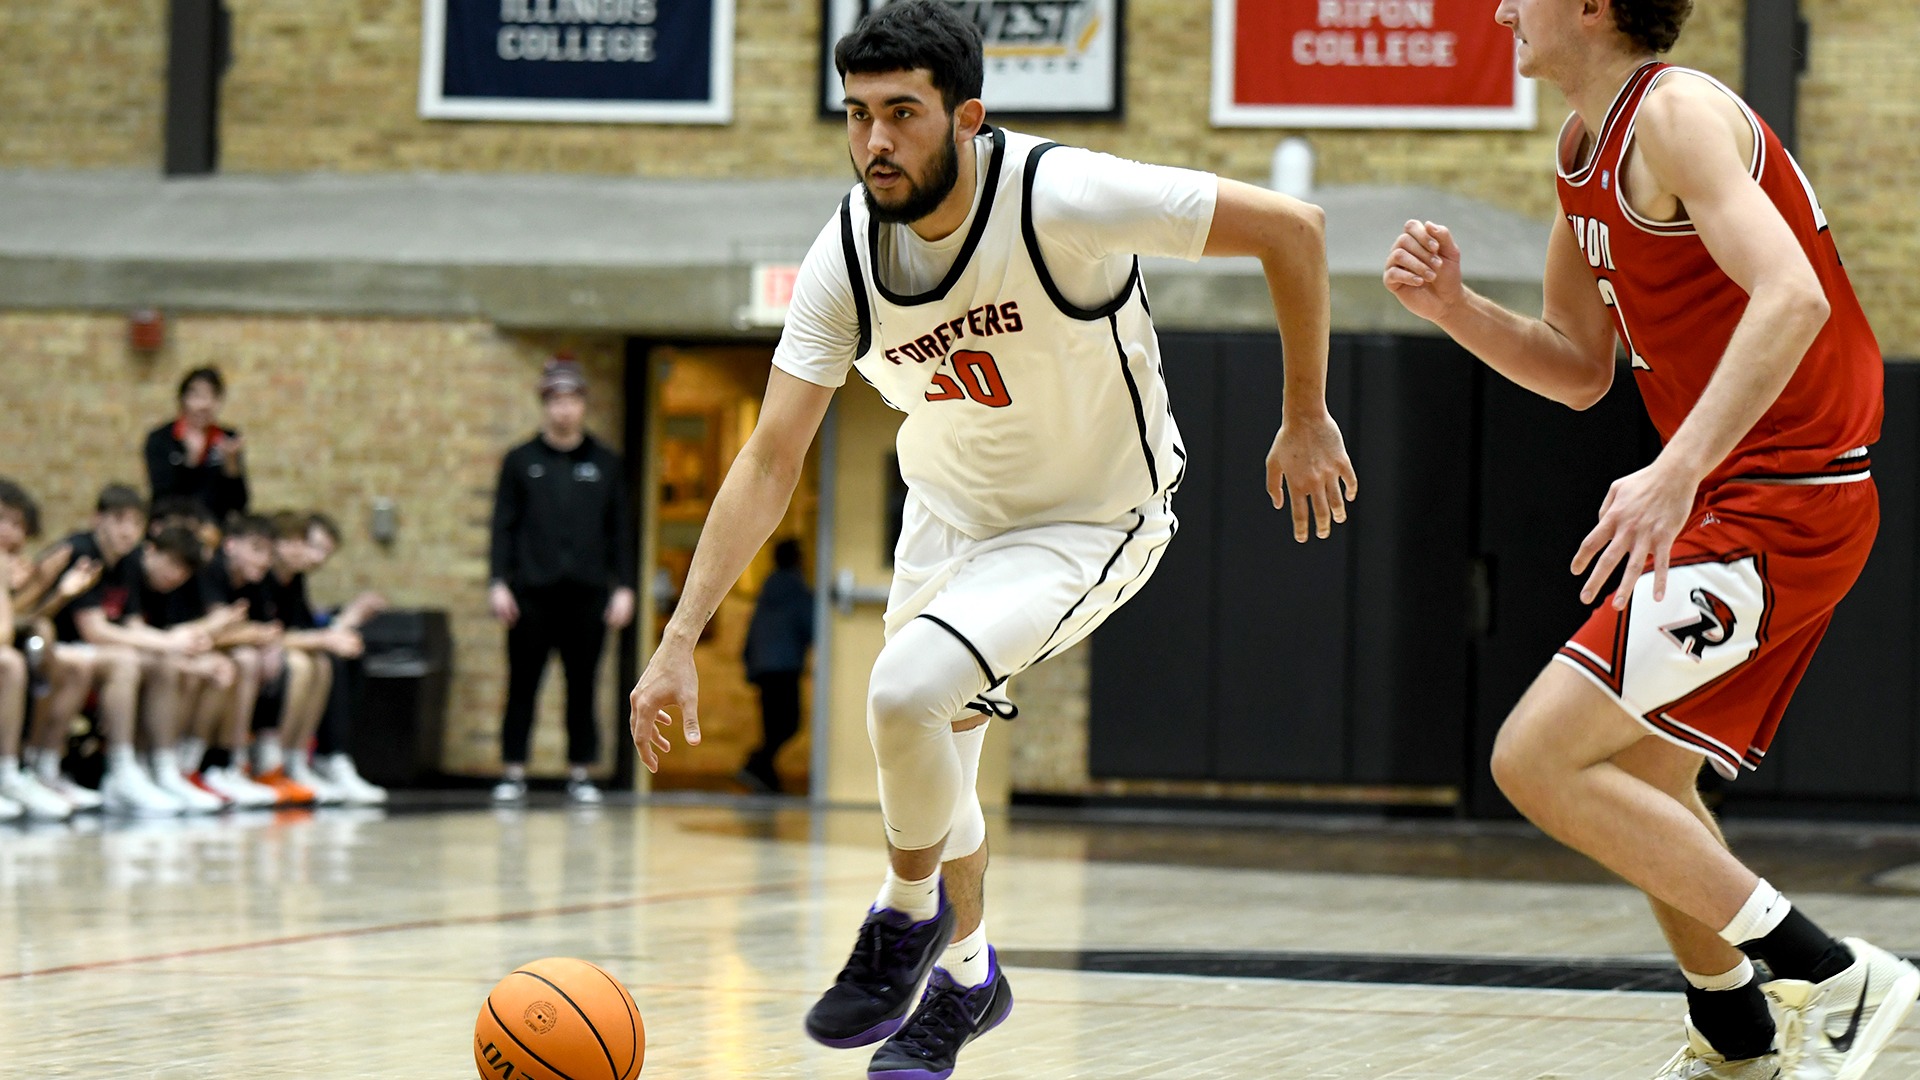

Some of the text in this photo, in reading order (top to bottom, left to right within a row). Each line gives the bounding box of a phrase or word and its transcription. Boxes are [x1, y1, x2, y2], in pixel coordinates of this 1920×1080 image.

[499, 0, 657, 23] ILLINOIS
[1317, 0, 1434, 28] RIPON
[497, 24, 657, 61] COLLEGE
[1292, 30, 1457, 67] COLLEGE
[884, 300, 1024, 366] FOREERS
